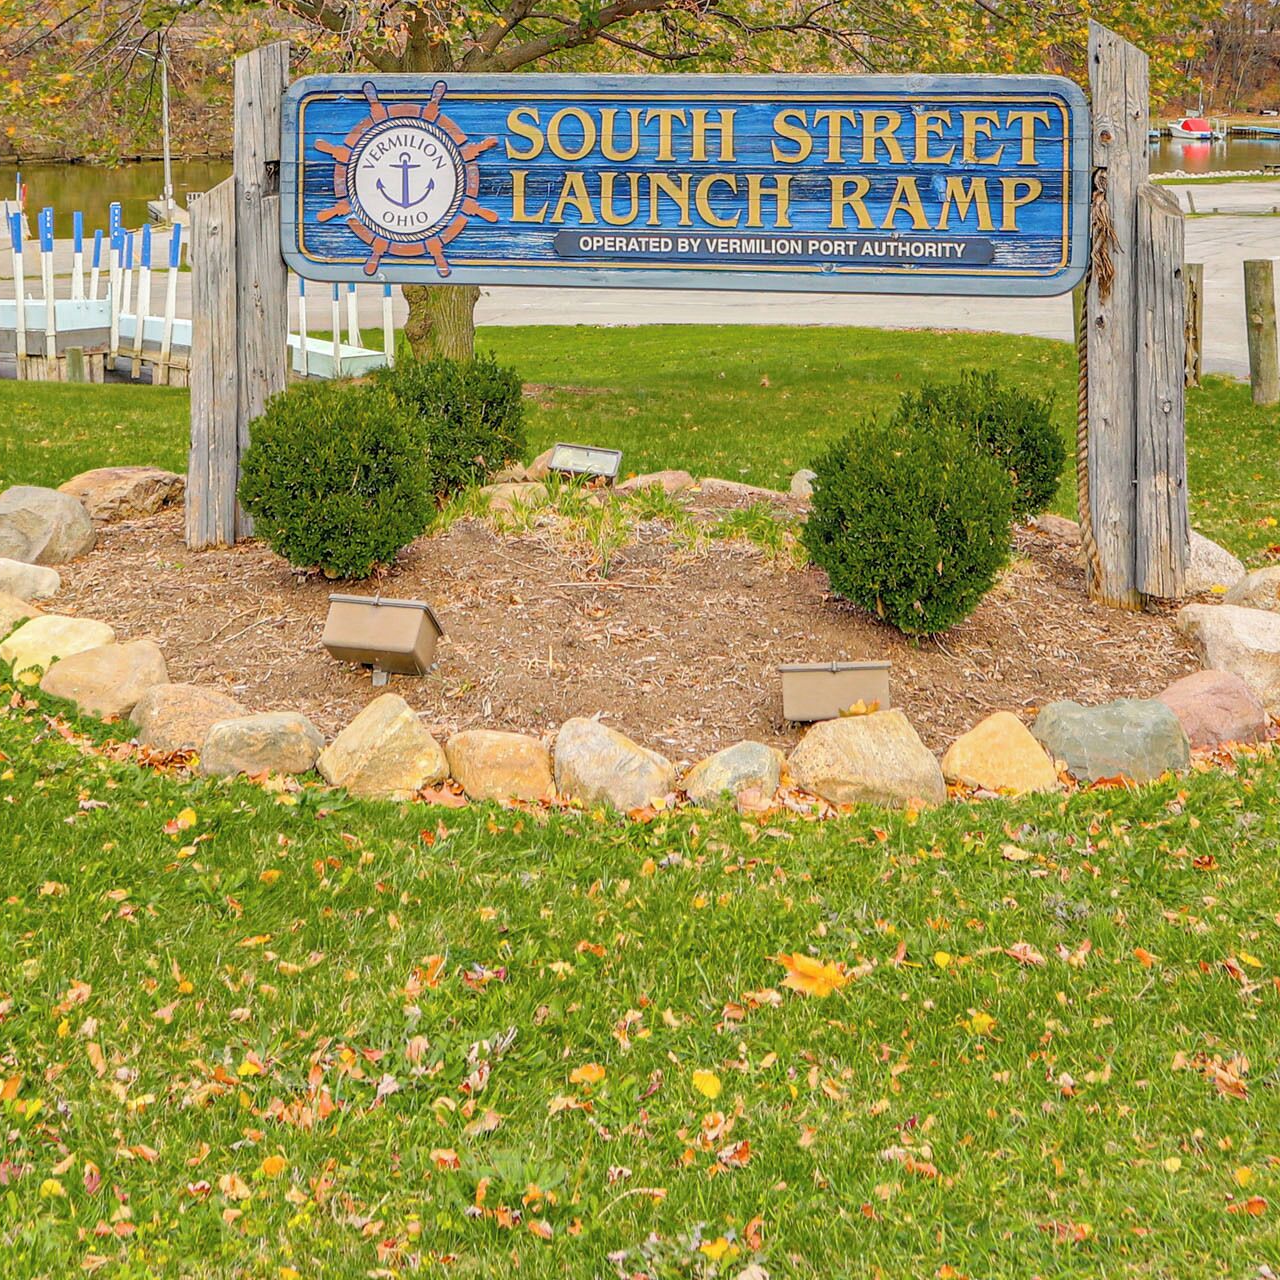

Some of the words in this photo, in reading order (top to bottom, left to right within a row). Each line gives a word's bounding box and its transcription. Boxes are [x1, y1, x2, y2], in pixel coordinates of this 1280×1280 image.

[362, 134, 447, 170] VERMILION
[504, 106, 738, 163] SOUTH
[770, 108, 1051, 166] STREET
[382, 211, 429, 227] OHIO
[508, 170, 794, 228] LAUNCH
[827, 174, 1043, 232] RAMP
[578, 236, 673, 253] OPERATED
[677, 237, 702, 253] BY
[704, 237, 803, 255] VERMILION
[807, 240, 858, 256] PORT
[861, 241, 966, 258] AUTHORITY
